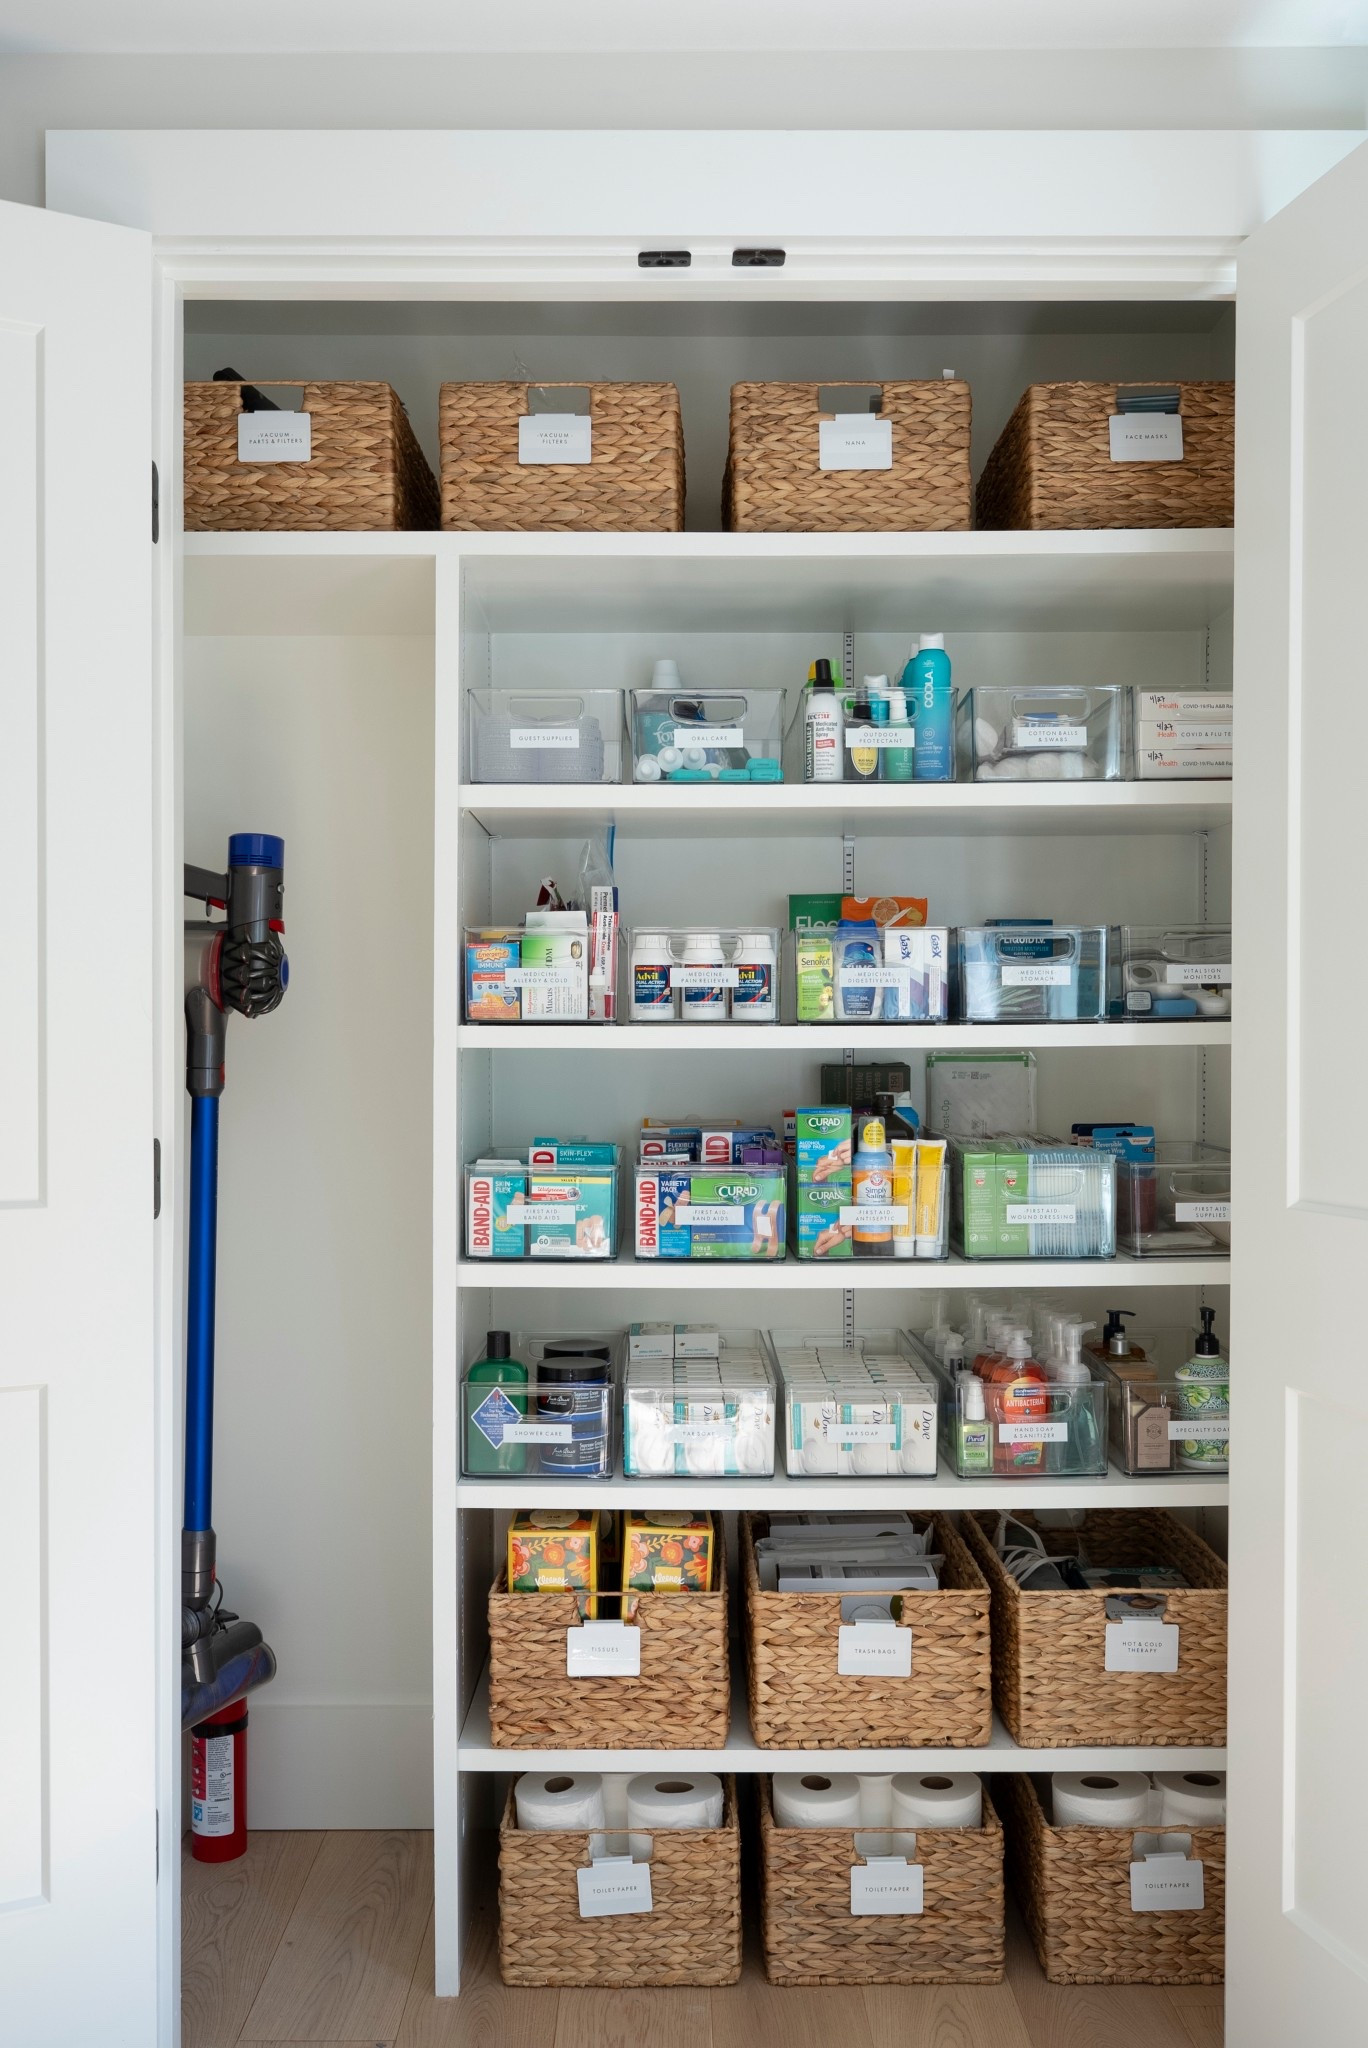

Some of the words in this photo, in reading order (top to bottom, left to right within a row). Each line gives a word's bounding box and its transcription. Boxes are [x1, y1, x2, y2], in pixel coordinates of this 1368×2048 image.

[801, 956, 830, 966] Senokot
[637, 972, 659, 981] Advil
[545, 987, 553, 1014] Mucus
[808, 1117, 841, 1128] CURAD
[718, 1185, 758, 1198] CURAD
[865, 1187, 887, 1195] Simply
[1006, 1398, 1045, 1407] ANTIBACTERIAL
[922, 1410, 934, 1441] Dove
[535, 1575, 569, 1587] Kleenex
[651, 1573, 685, 1585] Kleenex
[592, 1886, 616, 1895] TOILET
[616, 1885, 638, 1893] PAPER
